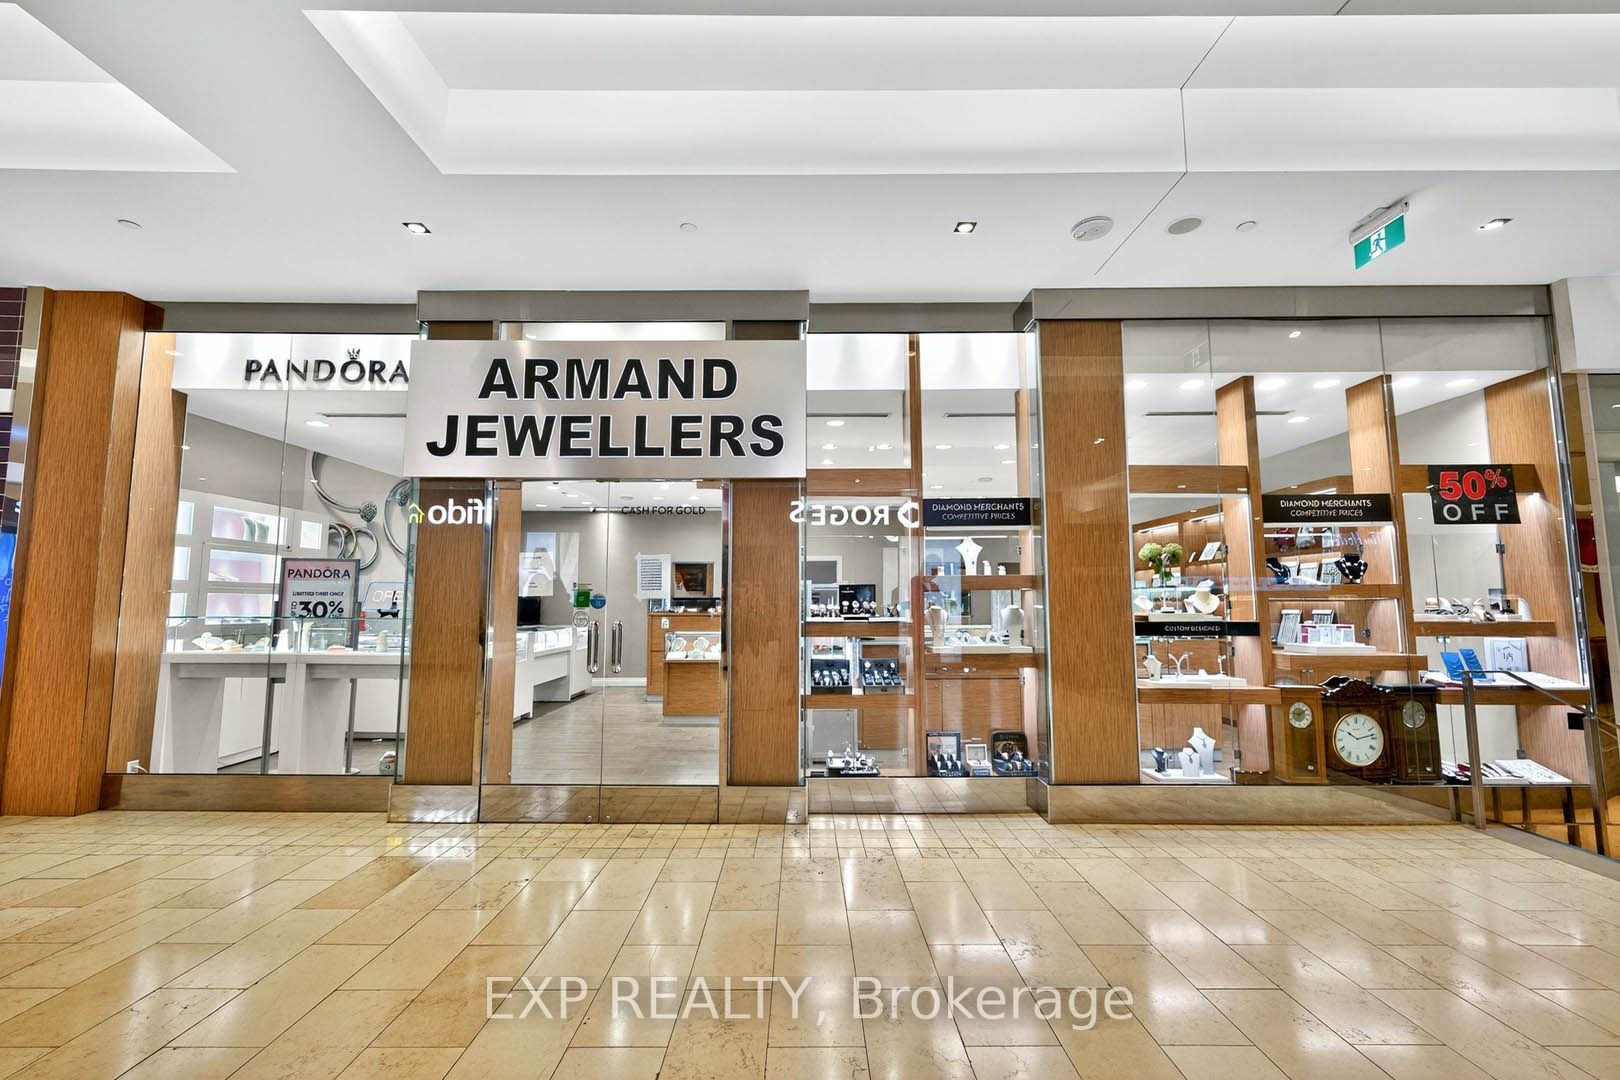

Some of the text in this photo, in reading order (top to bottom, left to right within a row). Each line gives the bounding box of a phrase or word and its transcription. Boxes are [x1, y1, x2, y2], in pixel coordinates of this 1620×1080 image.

[244, 359, 409, 383] PANDORA
[478, 358, 738, 400] ARMAND
[426, 414, 785, 457] JEWELLERS
[1439, 468, 1508, 500] 50%
[621, 506, 706, 515] CASH FOR GOLD
[932, 502, 1024, 511] DIAMOND MERCHANTS
[1280, 499, 1372, 508] DIAMOND MERCHANTS
[942, 512, 1016, 521] COMPETITIVE PRICES
[1290, 509, 1363, 517] COMPETITIVE PRICES
[1443, 503, 1509, 521] OFF
[287, 568, 351, 579] PANDORA
[298, 600, 345, 618] 30%
